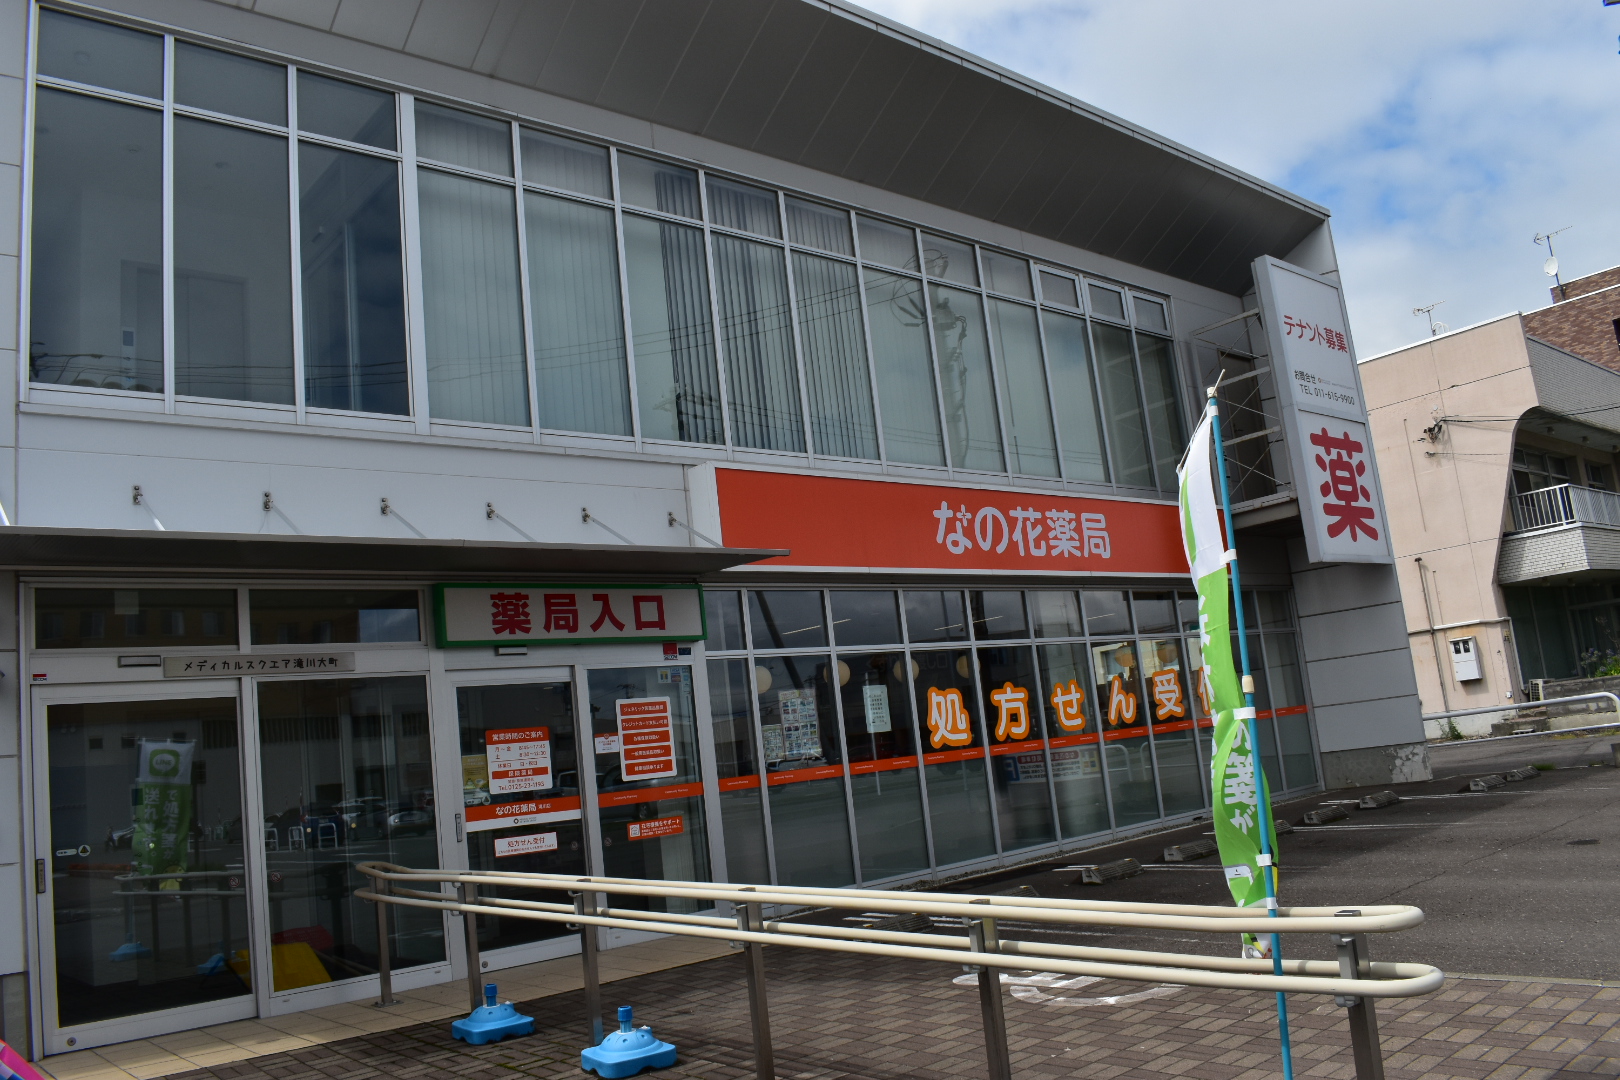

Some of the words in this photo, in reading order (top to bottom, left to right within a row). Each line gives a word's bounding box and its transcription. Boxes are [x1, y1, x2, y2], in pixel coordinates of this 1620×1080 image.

[1283, 314, 1348, 354] テナント募集
[1294, 370, 1316, 384] お問合せ
[1299, 384, 1313, 396] TEL
[1309, 427, 1379, 542] 薬
[933, 500, 1111, 559] なの花薬局
[489, 592, 666, 635] 薬局入口
[184, 657, 339, 672] メディカルスクエア滝川大町
[492, 731, 544, 741] 営業時間のご案内
[495, 803, 537, 815] なの花薬局
[507, 836, 546, 848] 処方せん受付
